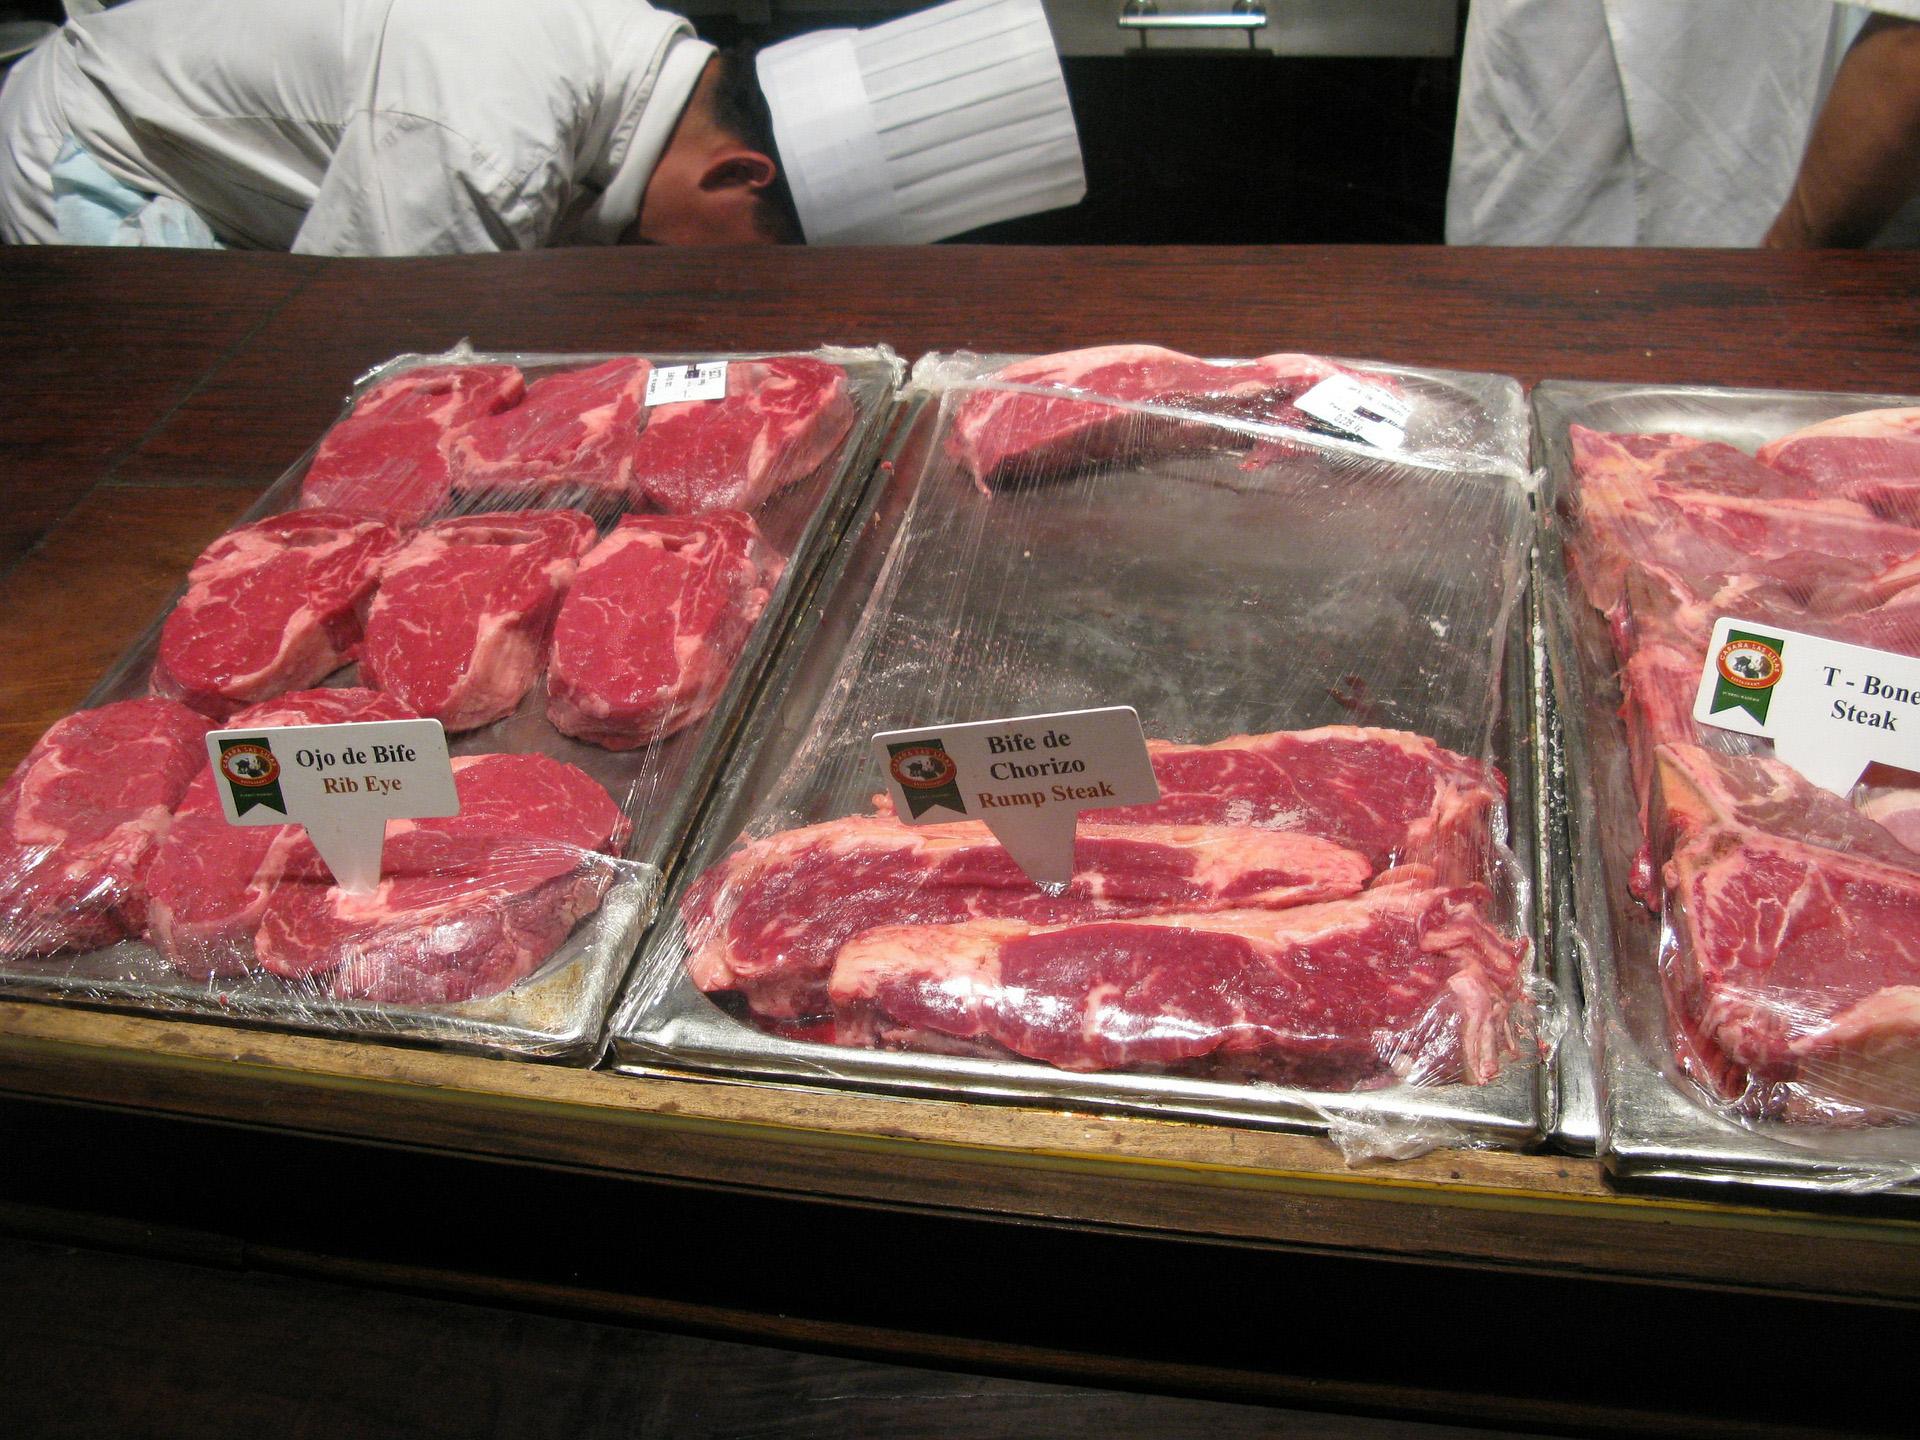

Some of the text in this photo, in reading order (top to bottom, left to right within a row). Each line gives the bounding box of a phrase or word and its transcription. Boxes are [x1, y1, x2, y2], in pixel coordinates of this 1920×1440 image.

[1719, 641, 1749, 661] CABAÑA
[1767, 651, 1781, 673] LILAS
[1823, 666, 1841, 687] T
[1860, 674, 1920, 706] Bone
[1831, 699, 1898, 731] Steak
[986, 730, 1071, 754] Bife de
[296, 744, 416, 771] Ojo de Bife
[990, 757, 1085, 781] Chorizo
[322, 775, 402, 795] Rib Eye
[978, 781, 1116, 808] Rump Steak
